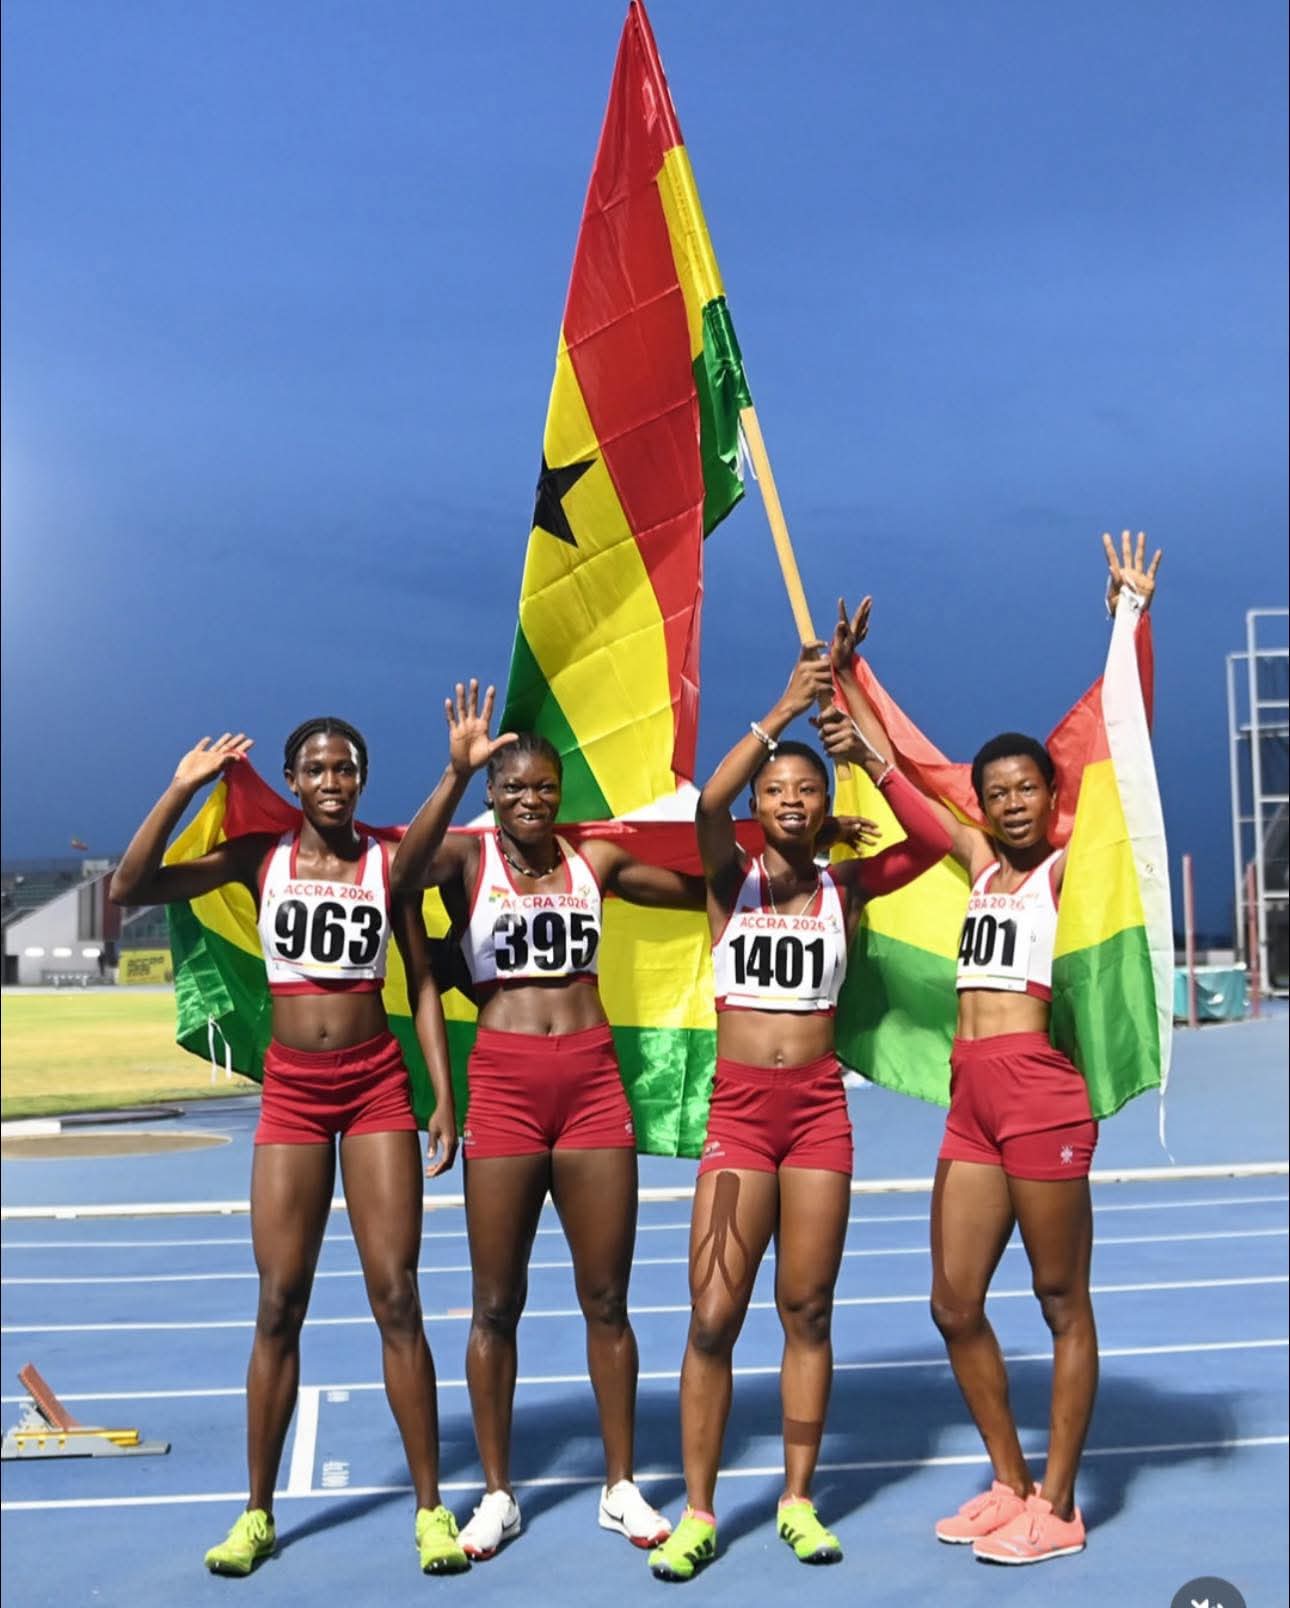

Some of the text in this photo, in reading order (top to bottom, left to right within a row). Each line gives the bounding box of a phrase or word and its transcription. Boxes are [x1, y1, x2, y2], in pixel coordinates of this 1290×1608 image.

[284, 884, 374, 901] ACCRA 2026
[559, 895, 588, 909] 2026
[275, 899, 382, 964] 963
[492, 911, 600, 971] 395
[740, 916, 826, 932] ACCRA 2026
[729, 934, 824, 989] 1401
